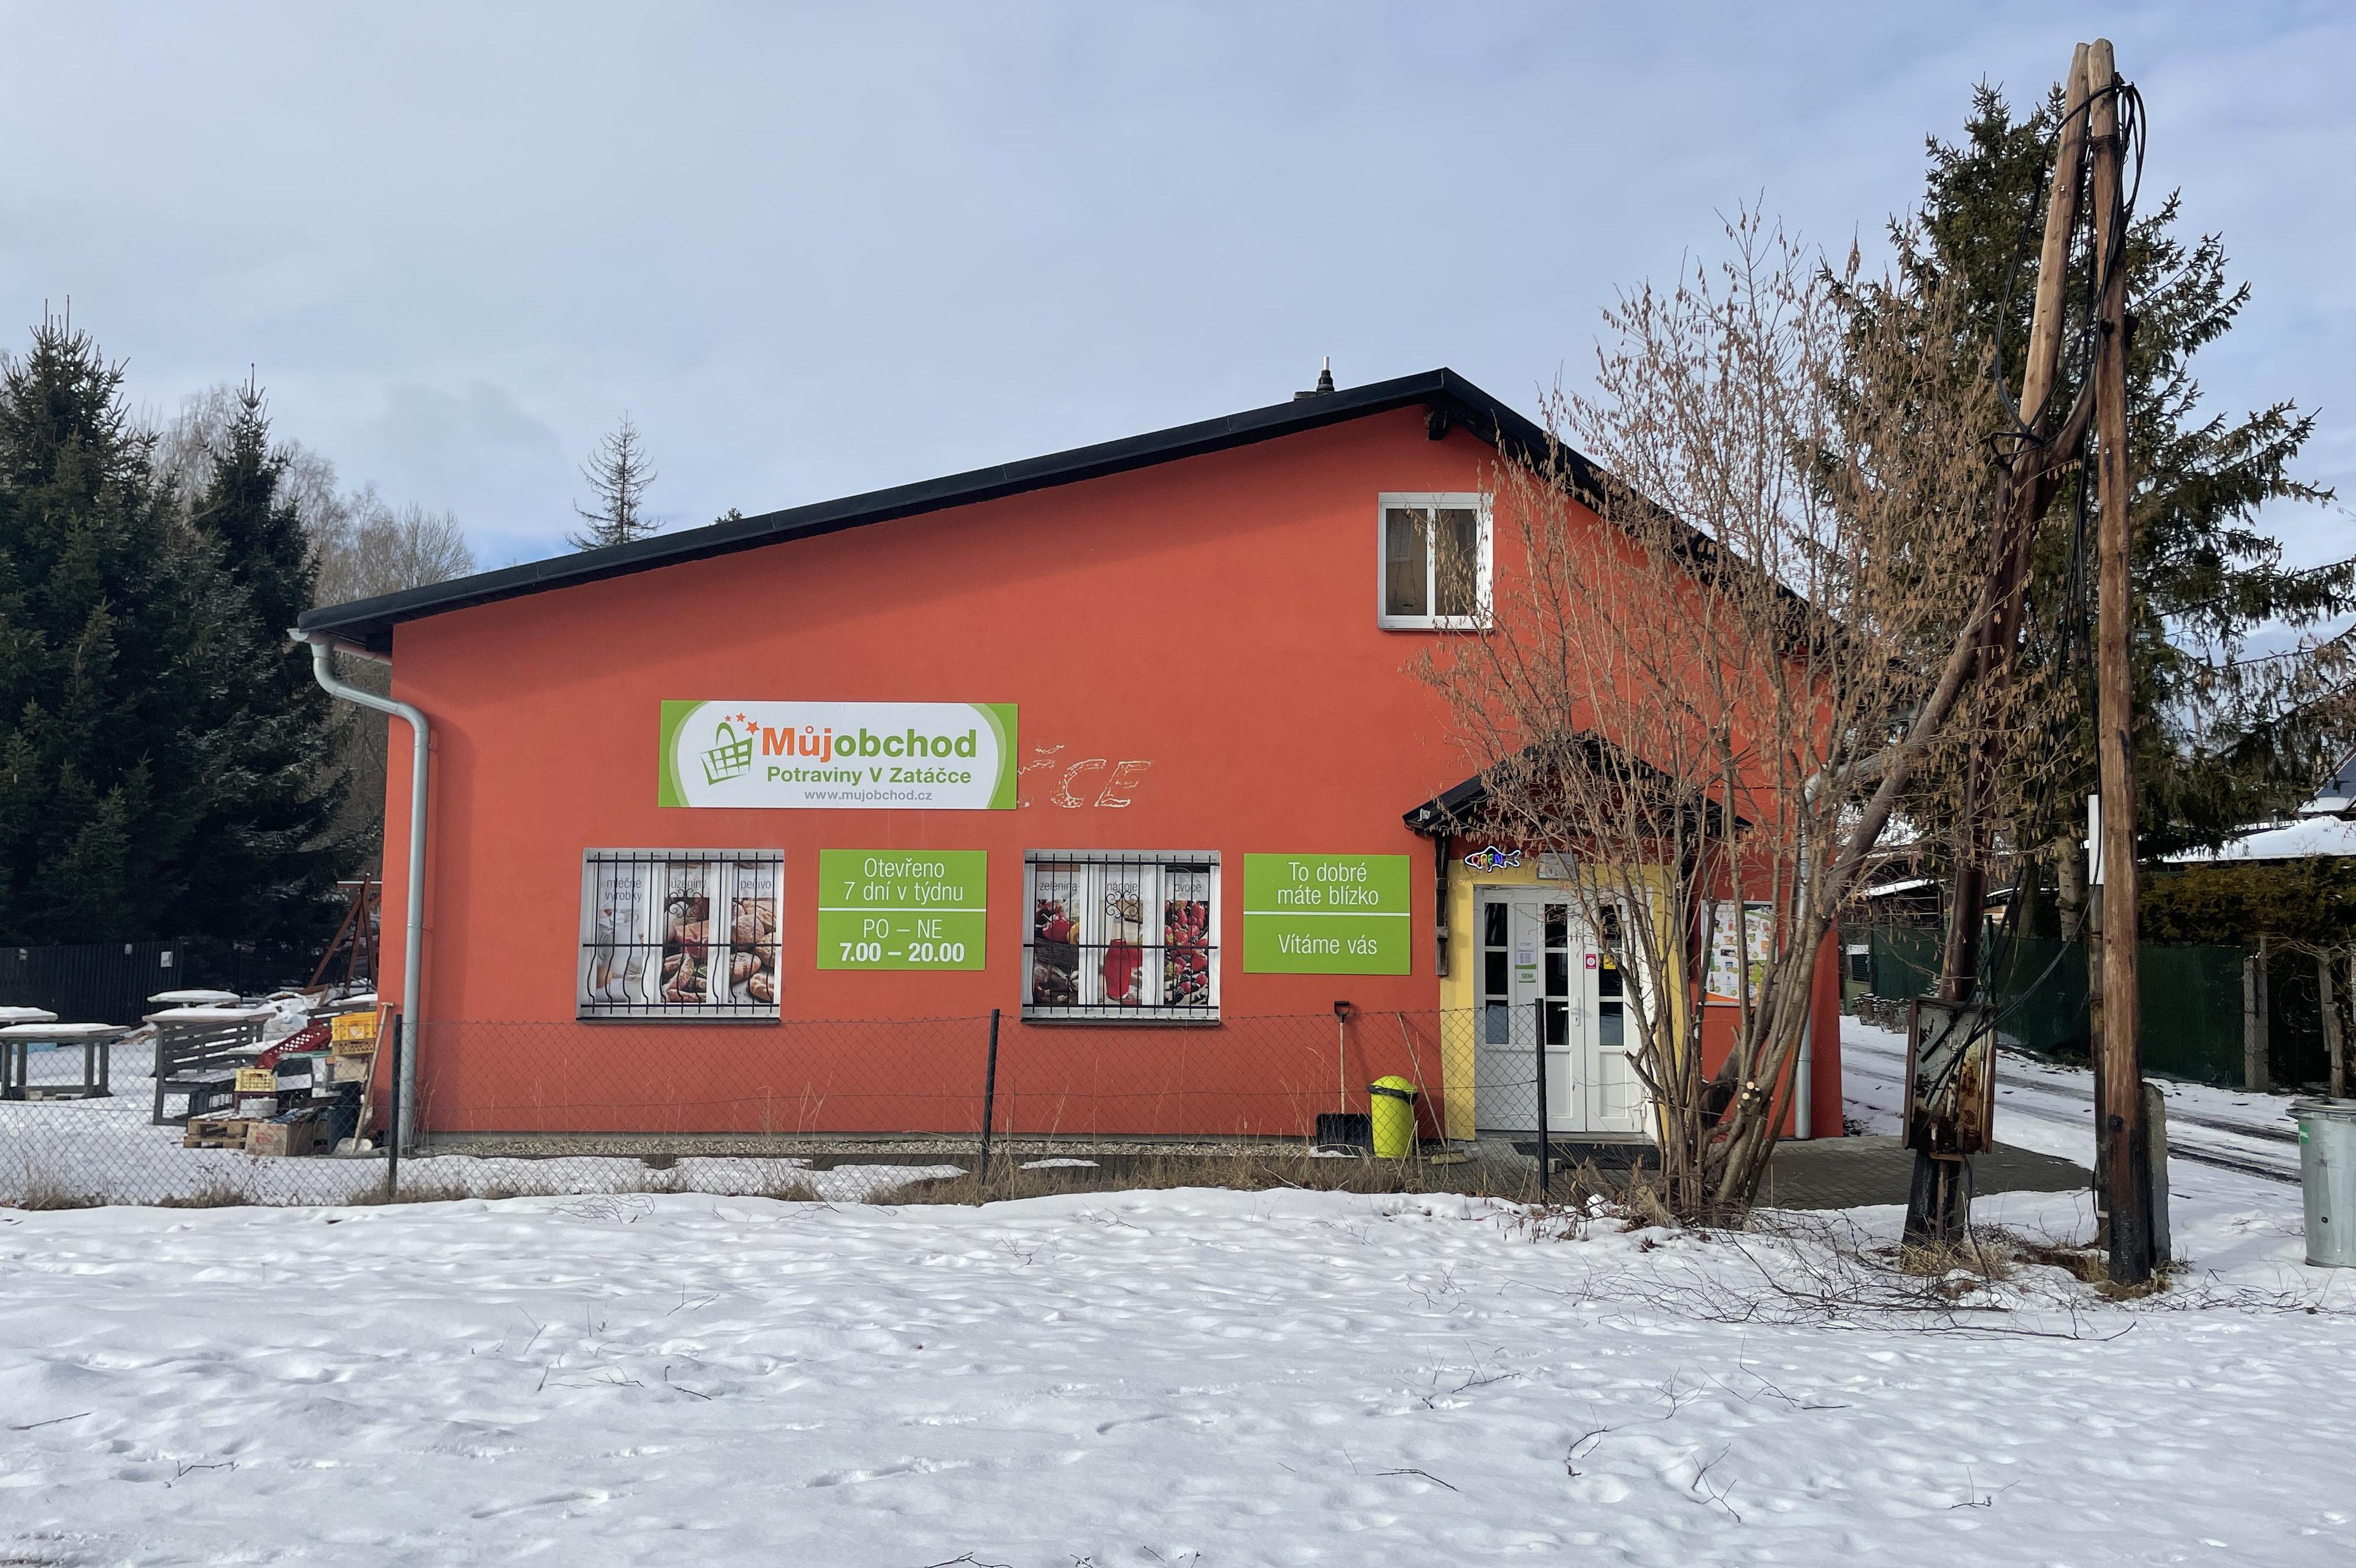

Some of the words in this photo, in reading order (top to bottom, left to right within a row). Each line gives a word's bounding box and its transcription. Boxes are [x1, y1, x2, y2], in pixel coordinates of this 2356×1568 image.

[762, 725, 976, 763] Můjobchod
[767, 766, 862, 786] Potraviny
[869, 767, 883, 782] V
[889, 767, 972, 784] Zatáčce
[804, 789, 932, 802] www.mujobchod.cz
[864, 858, 945, 878] Otevřeno
[1288, 862, 1309, 882] To
[1316, 862, 1367, 882] dobré
[607, 878, 641, 888] méčné
[843, 881, 855, 900] 7
[863, 881, 891, 901] dní
[897, 886, 907, 900] v
[914, 881, 963, 905] týdnu
[1040, 881, 1077, 891] zelenina
[1174, 884, 1202, 892] ovoce
[1277, 884, 1321, 905] máte
[1329, 885, 1379, 905] blízko
[863, 919, 889, 938] PO
[918, 919, 942, 938] NE
[839, 942, 881, 962] 7.00
[908, 942, 965, 962] 20.00
[1278, 934, 1340, 954] Vítáme
[1347, 935, 1378, 955] vás
